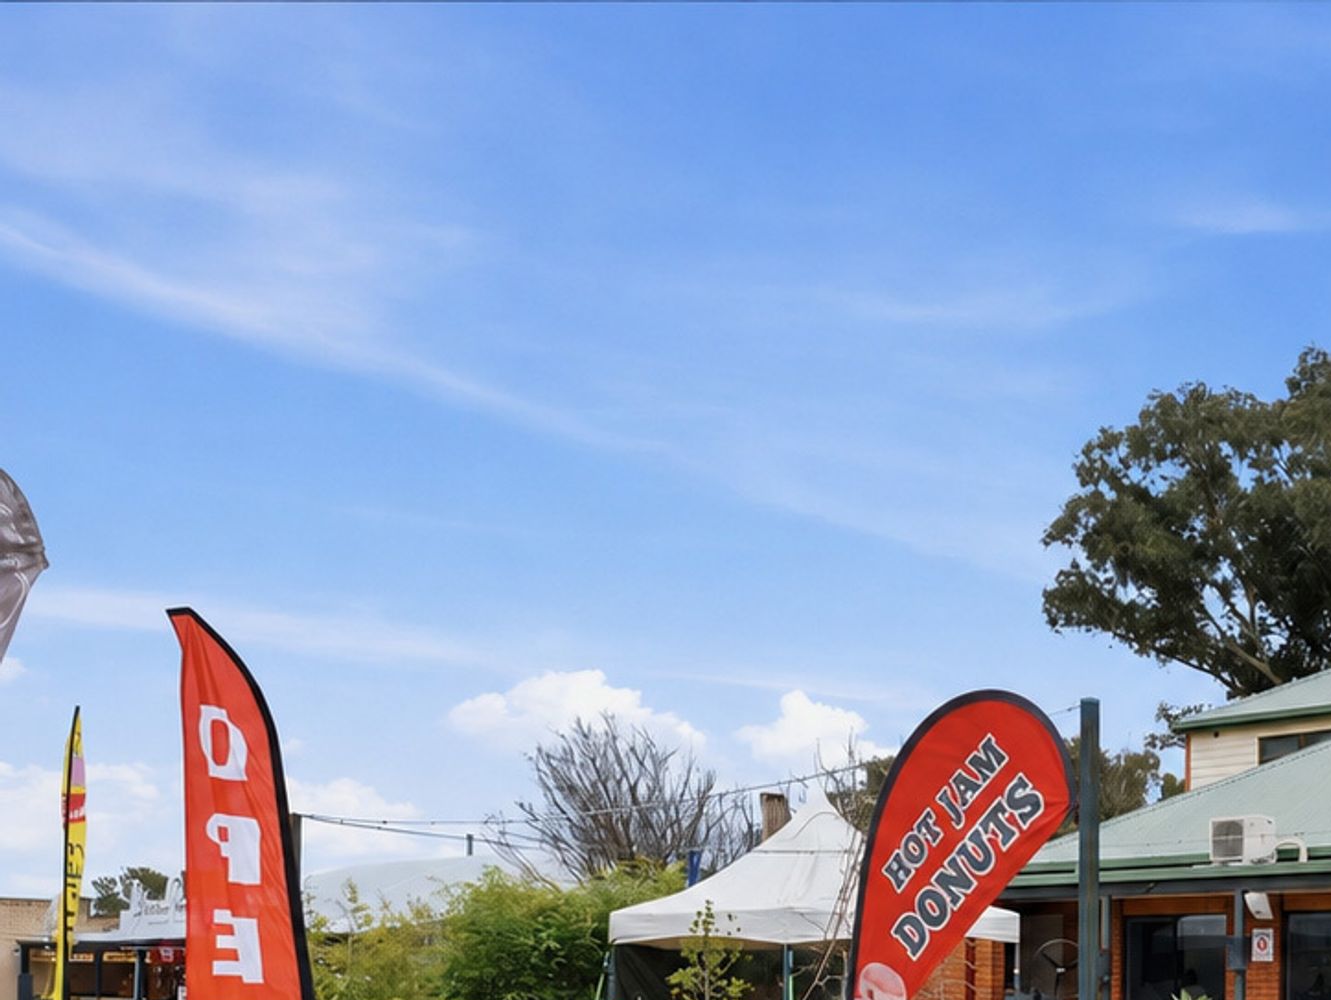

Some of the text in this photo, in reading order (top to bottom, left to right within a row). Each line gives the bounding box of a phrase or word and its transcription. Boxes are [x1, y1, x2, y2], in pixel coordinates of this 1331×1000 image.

[882, 733, 1009, 893] HOT JAM
[891, 772, 1045, 961] DONUTS
